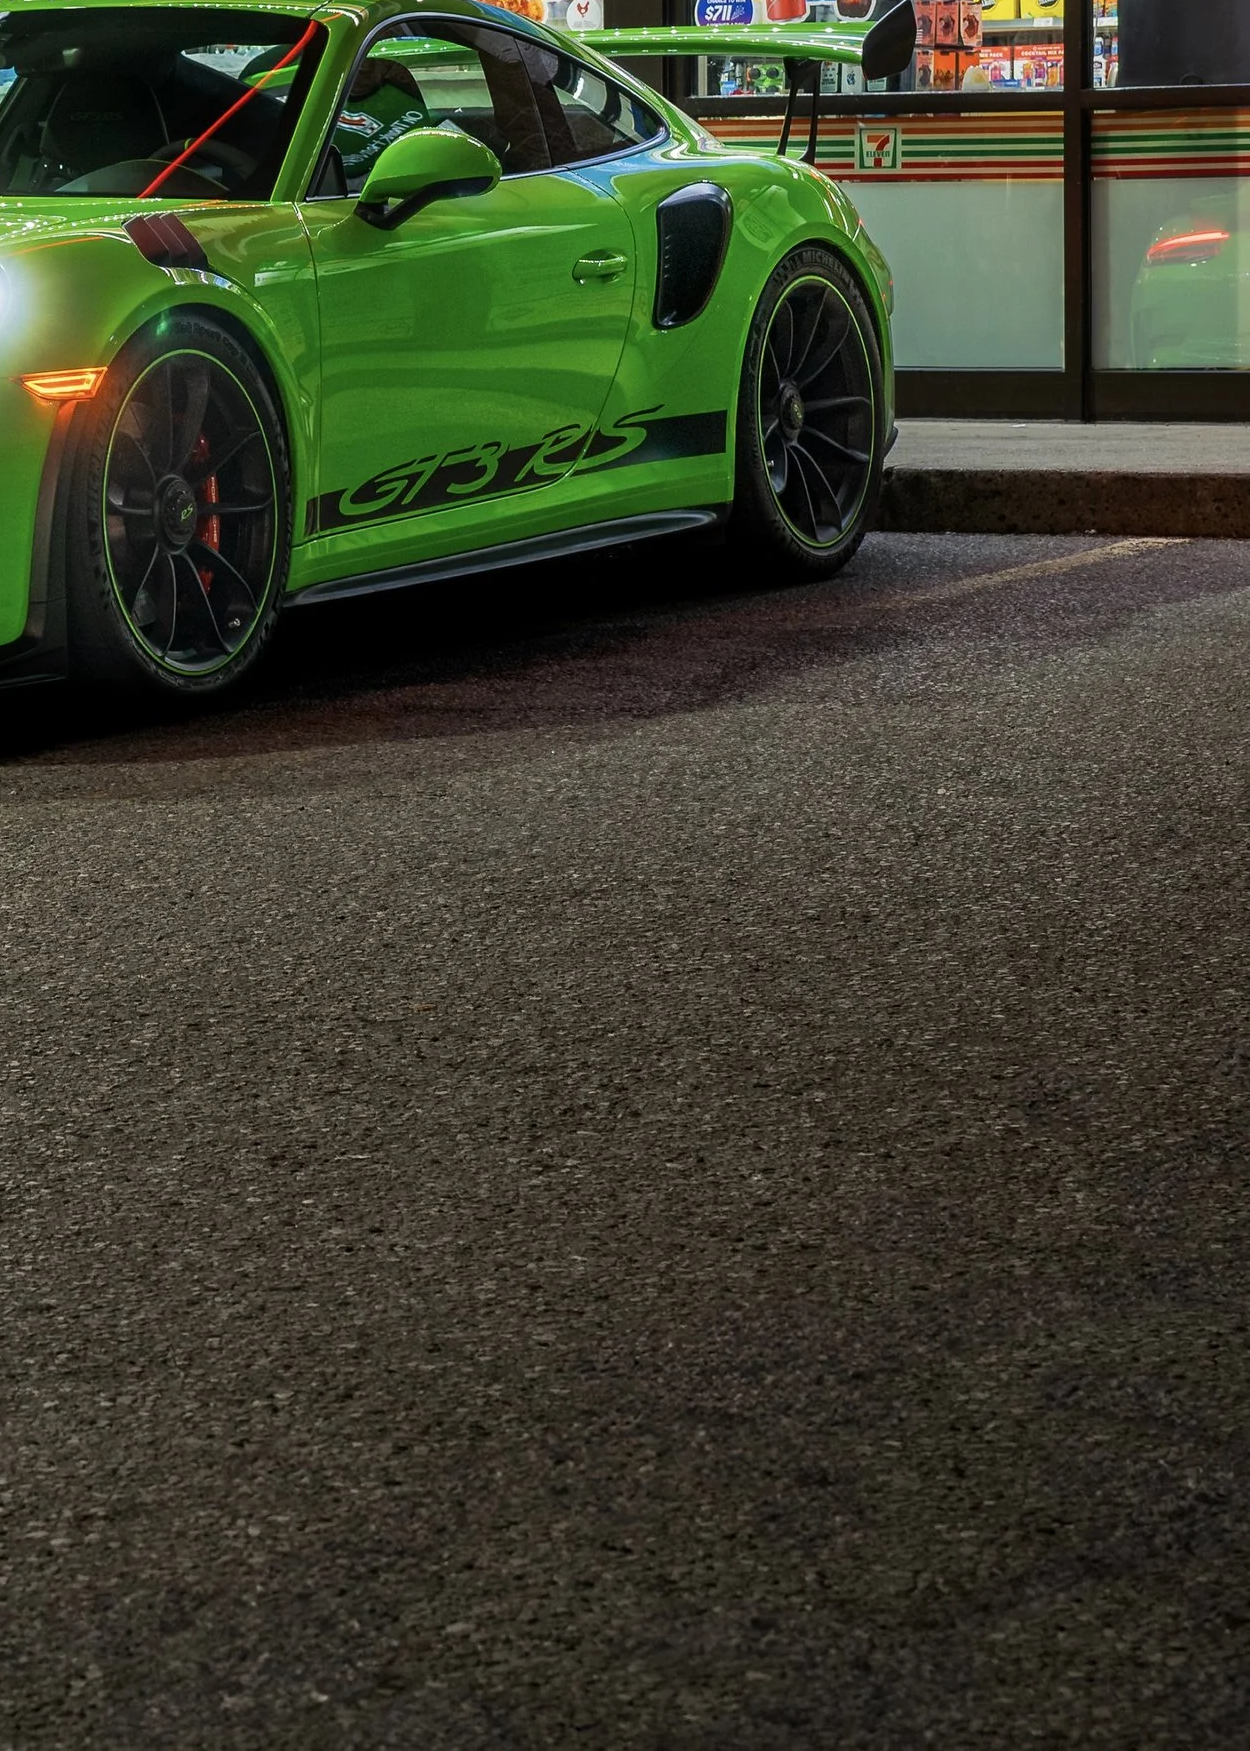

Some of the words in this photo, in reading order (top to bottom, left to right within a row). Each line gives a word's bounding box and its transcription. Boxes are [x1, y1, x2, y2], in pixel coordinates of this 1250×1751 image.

[704, 5, 733, 21] $711
[338, 441, 509, 517] GT3
[515, 403, 665, 483] RS
